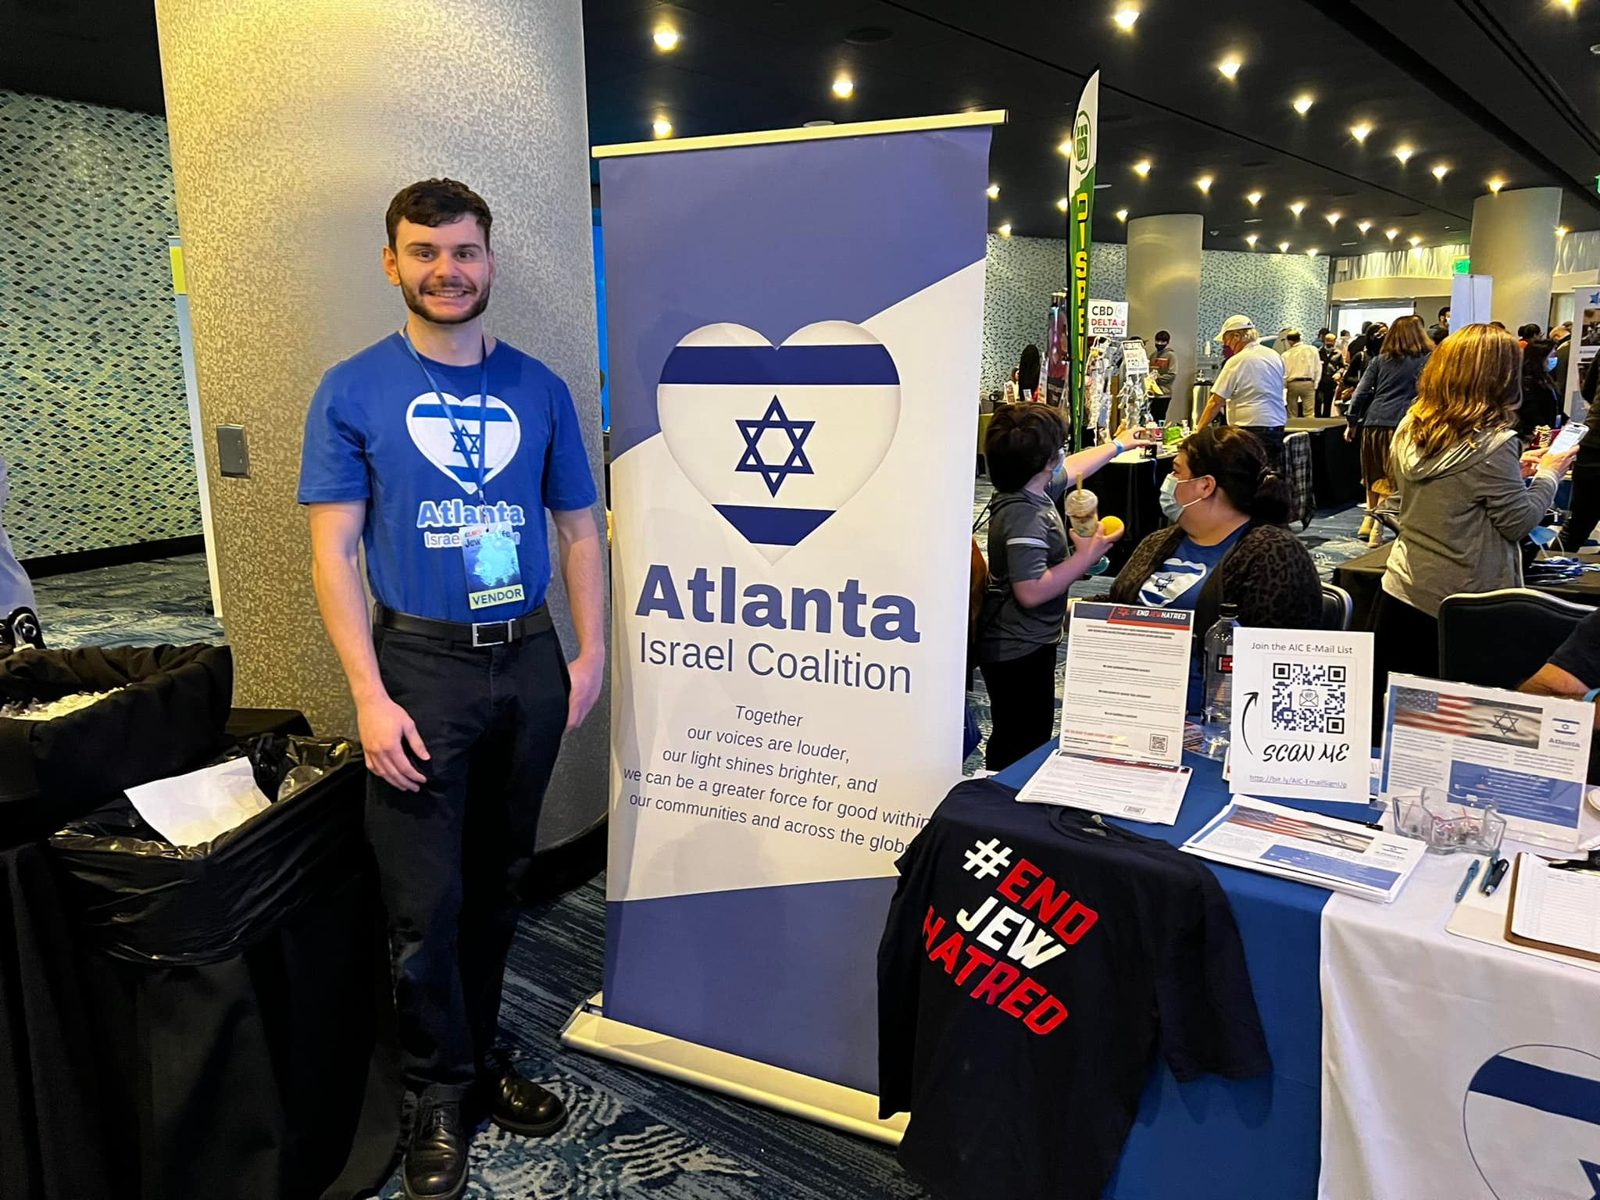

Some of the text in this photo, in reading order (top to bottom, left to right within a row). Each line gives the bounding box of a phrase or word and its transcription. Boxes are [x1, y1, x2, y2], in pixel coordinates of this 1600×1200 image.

[1092, 306, 1114, 316] CBD
[417, 500, 525, 527] Atlanta
[426, 534, 460, 547] Israe
[472, 588, 522, 604] VENDOR
[635, 564, 921, 643] Atlanta
[641, 632, 911, 693] Israel Coalition
[1252, 642, 1353, 654] Join the AIC E-Mail List
[735, 705, 803, 728] Together
[687, 727, 850, 764] our voices are louder,
[1262, 743, 1350, 763] SCAN ME
[662, 748, 877, 794] our light shines brighter, and
[623, 767, 641, 781] we
[646, 771, 671, 786] can
[676, 770, 694, 789] be
[699, 778, 708, 791] a
[712, 779, 765, 801] greater
[769, 788, 807, 808] force
[812, 795, 833, 812] for
[837, 799, 877, 821] good
[630, 793, 652, 807] our
[655, 797, 747, 824] communities
[751, 812, 780, 830] and
[784, 821, 835, 840] across
[840, 828, 865, 846] the
[962, 838, 1098, 945] #END
[956, 896, 1067, 970] JEW
[922, 904, 1069, 1035] HATRED
